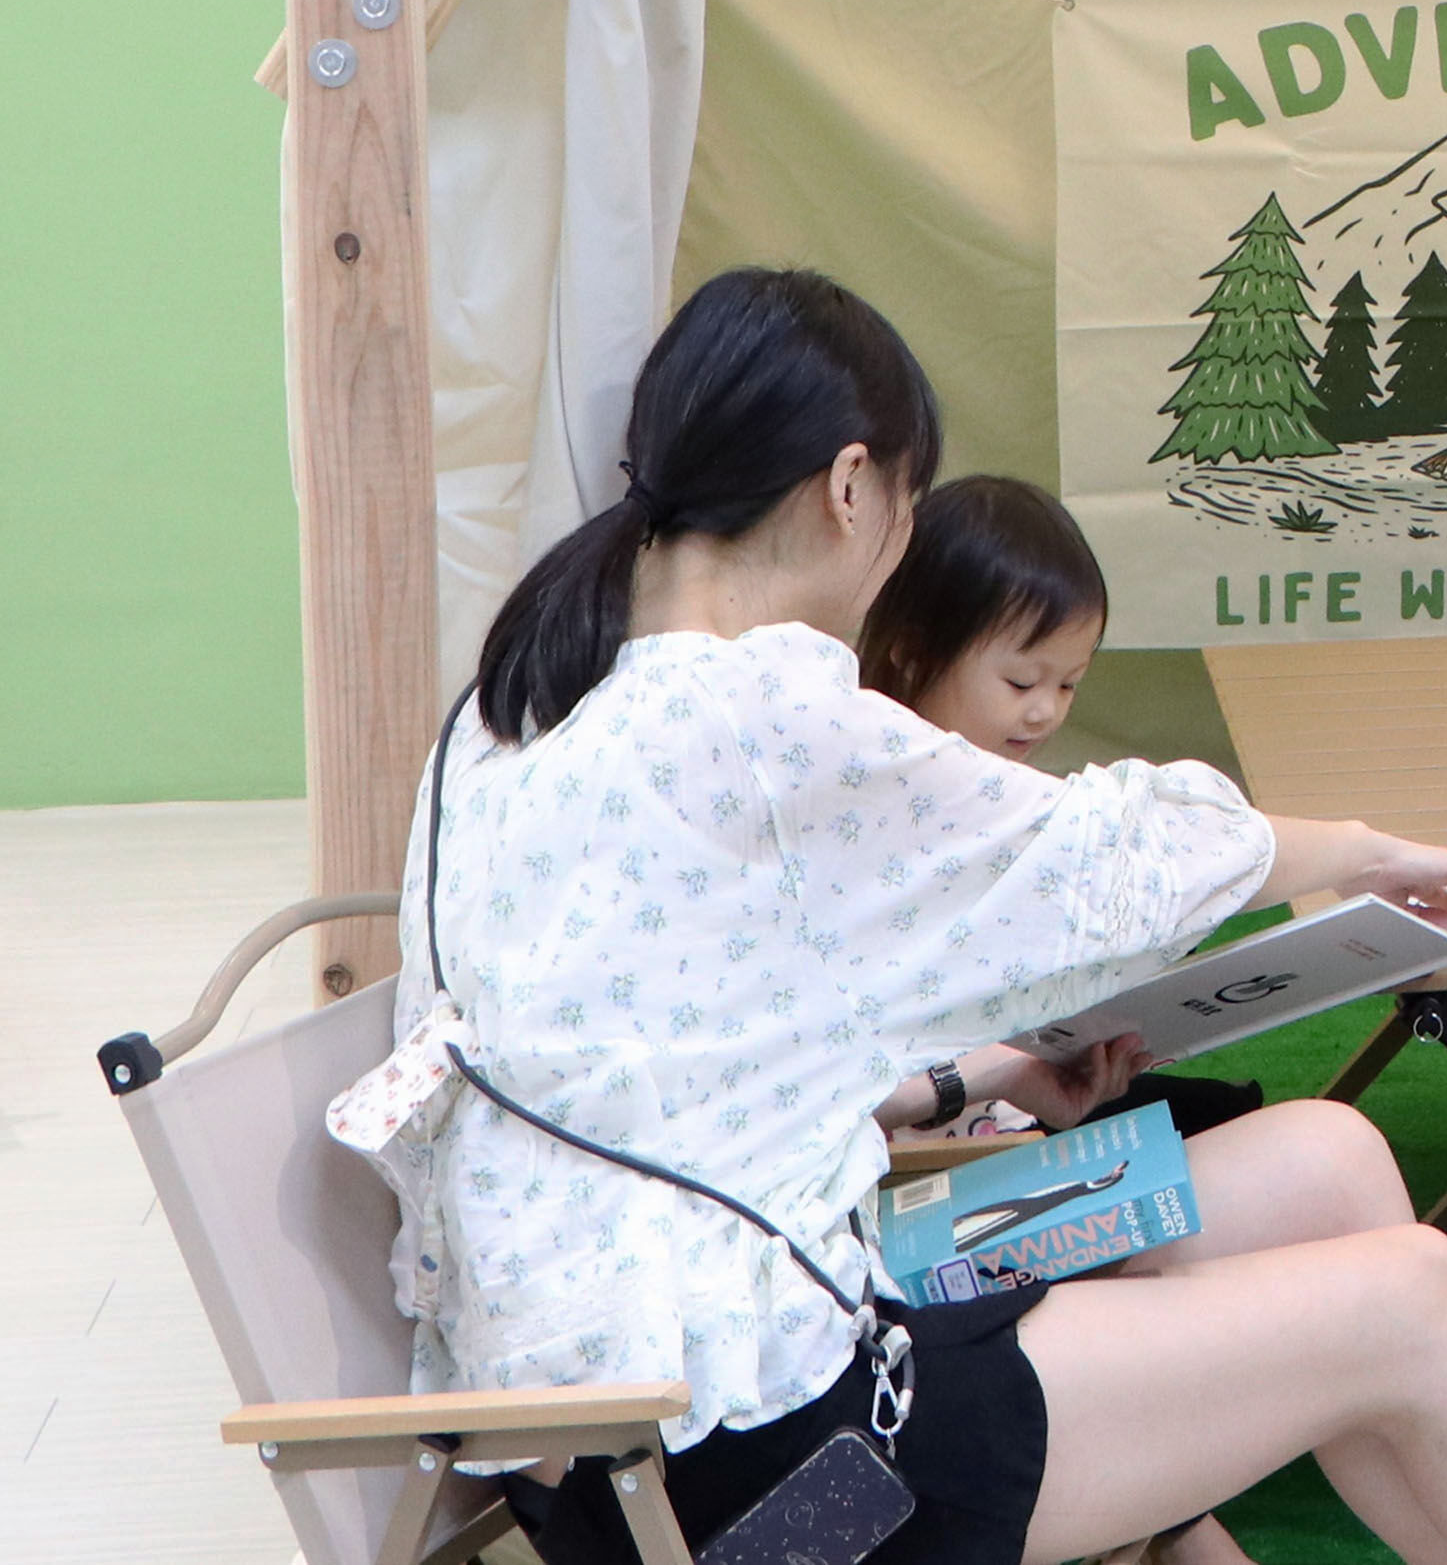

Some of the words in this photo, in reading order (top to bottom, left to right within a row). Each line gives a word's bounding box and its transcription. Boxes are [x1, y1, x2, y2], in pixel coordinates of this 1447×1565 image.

[1216, 572, 1361, 625] LIFE
[1121, 1201, 1145, 1248] POP-UP
[1153, 1191, 1177, 1237] DAVEY
[1165, 1187, 1189, 1235] OWEN
